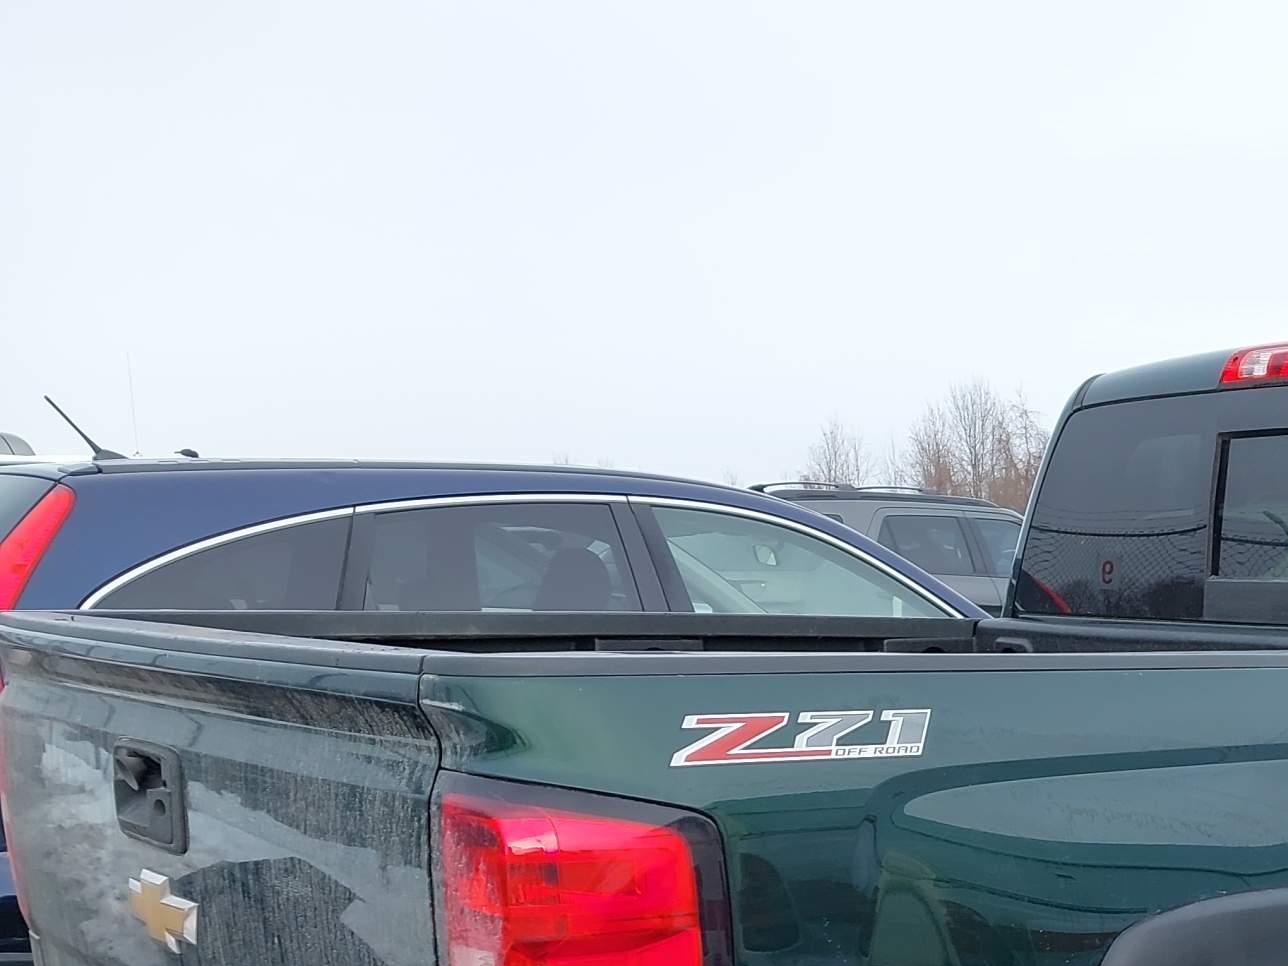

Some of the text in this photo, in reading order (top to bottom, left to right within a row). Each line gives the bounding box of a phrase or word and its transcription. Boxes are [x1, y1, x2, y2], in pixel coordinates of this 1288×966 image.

[669, 708, 932, 767] Z71
[834, 745, 920, 757] OFF ROAD
